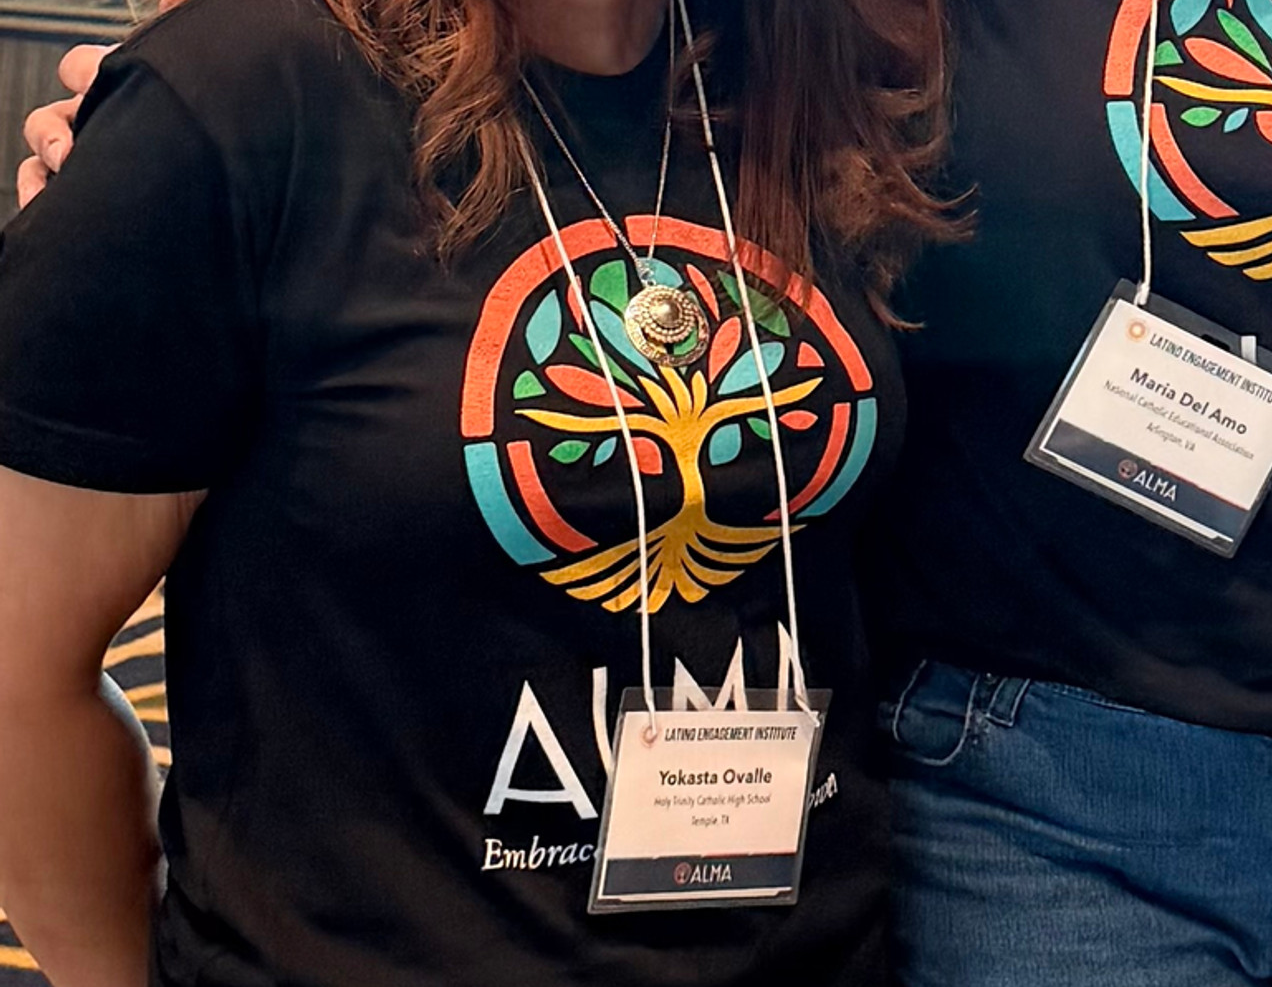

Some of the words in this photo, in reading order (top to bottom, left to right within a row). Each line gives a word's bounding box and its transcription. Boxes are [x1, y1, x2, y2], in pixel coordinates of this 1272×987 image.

[1149, 333, 1183, 359] LATINO
[1181, 349, 1241, 386] ENGAGEMENT
[1130, 368, 1176, 400] Maria
[1179, 392, 1210, 415] Del
[1208, 408, 1248, 435] Amo
[1133, 469, 1178, 501] ALMA
[664, 727, 696, 741] LATINO
[697, 726, 754, 741] ENGAGEMENT
[754, 725, 798, 740] INSTITUTE
[659, 769, 718, 786] Yokasta
[722, 767, 772, 784] Ovalle
[654, 797, 671, 809] Holy
[727, 794, 745, 808] High
[747, 792, 772, 805] School
[690, 863, 732, 884] ALMA
